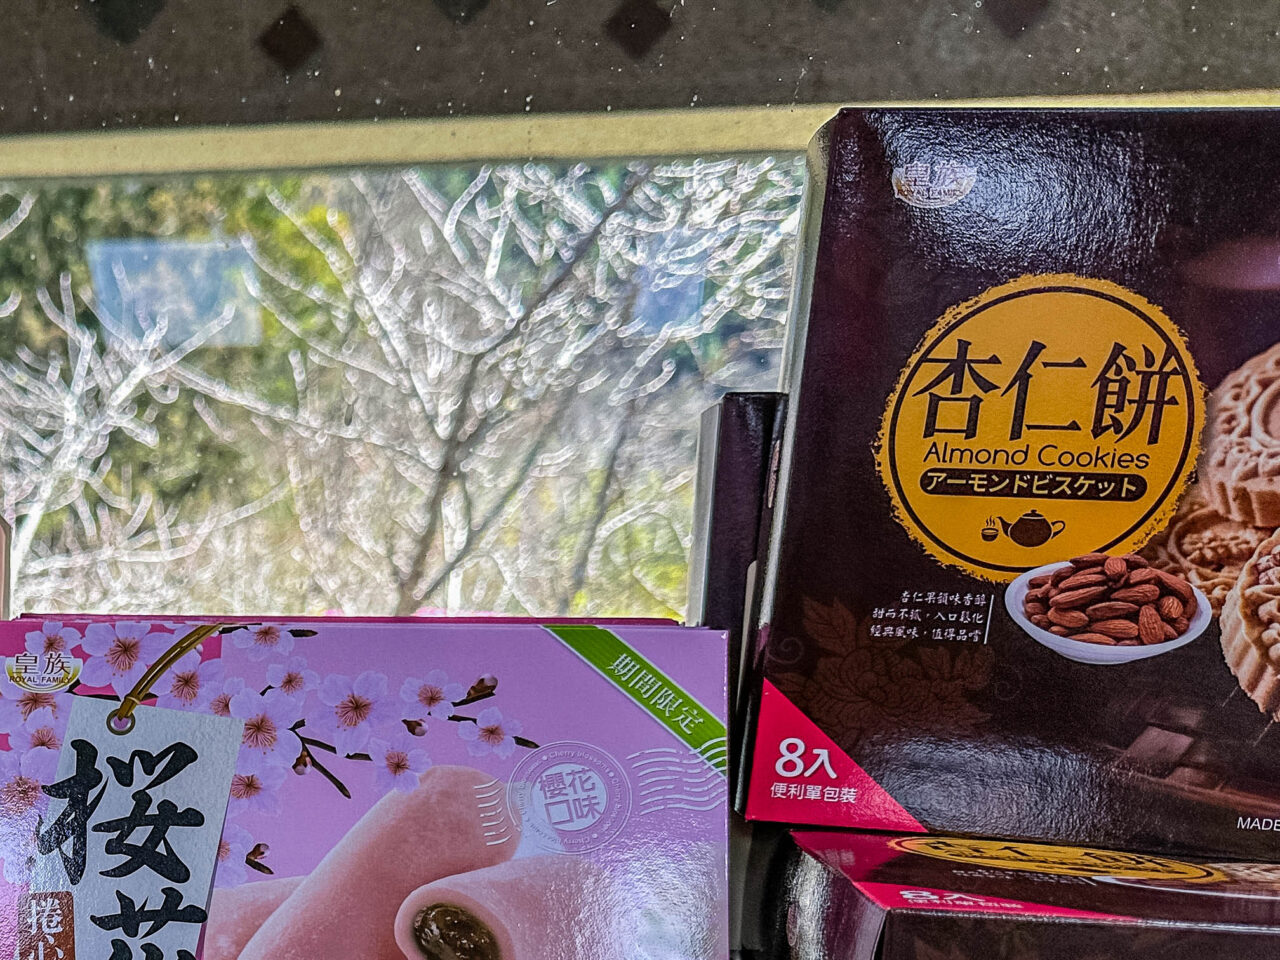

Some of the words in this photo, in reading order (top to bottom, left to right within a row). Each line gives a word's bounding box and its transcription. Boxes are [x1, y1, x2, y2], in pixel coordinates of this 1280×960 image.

[913, 338, 1183, 446] 杏仁餅
[923, 444, 1029, 467] Almond
[1038, 445, 1150, 470] Cookies
[925, 472, 1137, 499] アーモンドビスケット
[13, 653, 72, 676] 皇族
[9, 675, 38, 684] ROYAL
[41, 675, 72, 684] FAMILY
[607, 652, 704, 735] 期間限定
[775, 737, 837, 780] 8入
[538, 767, 596, 800] 櫻花
[769, 782, 857, 804] 便利單包裝
[544, 795, 602, 825] 口味
[1237, 816, 1280, 832] MADE
